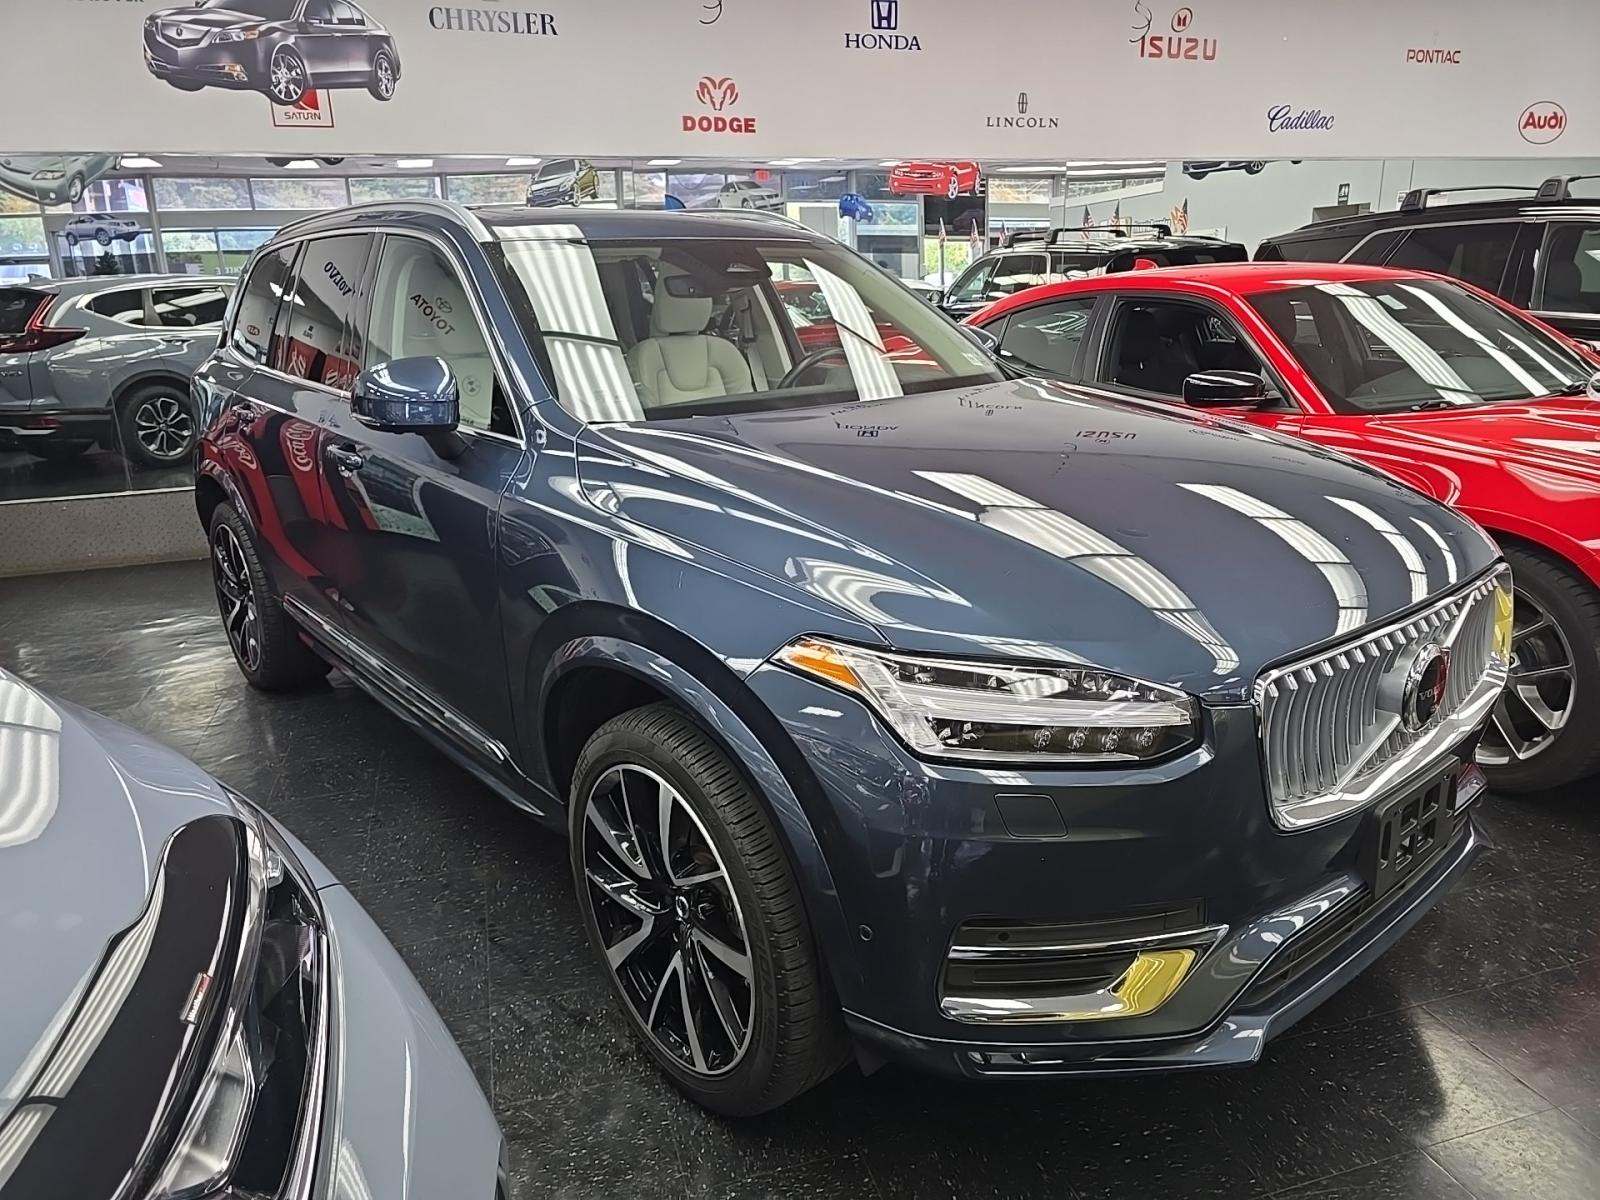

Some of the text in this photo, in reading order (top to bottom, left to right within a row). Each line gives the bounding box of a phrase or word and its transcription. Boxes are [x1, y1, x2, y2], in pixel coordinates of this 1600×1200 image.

[428, 6, 558, 36] CHRYSLER
[845, 33, 922, 51] HONDA
[1139, 36, 1217, 61] ISUZU
[1406, 49, 1461, 64] PONTIAC
[284, 111, 321, 121] SATURN
[682, 115, 757, 133] DODGE
[986, 116, 1060, 128] LINCOLN
[1267, 104, 1335, 132] Cadillac
[1522, 111, 1564, 129] Audi
